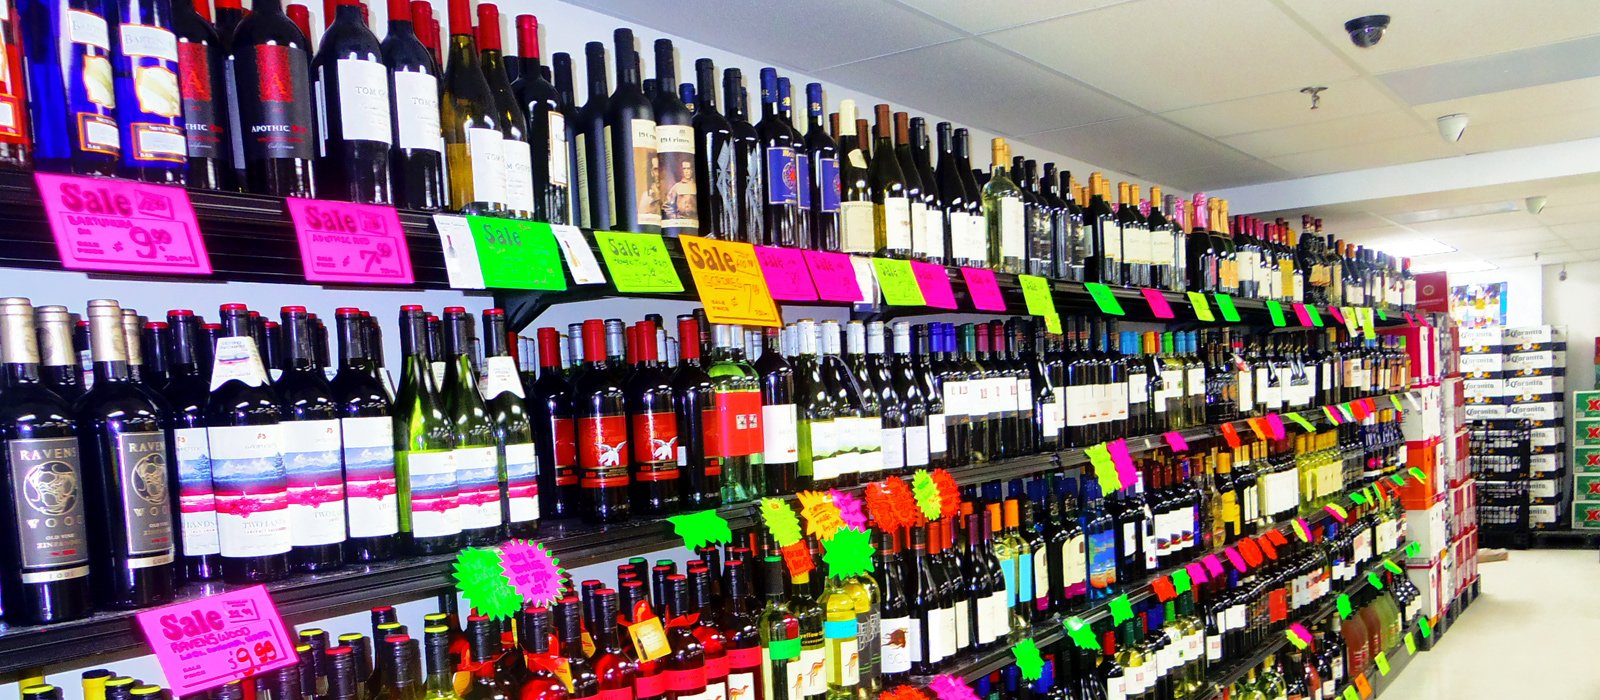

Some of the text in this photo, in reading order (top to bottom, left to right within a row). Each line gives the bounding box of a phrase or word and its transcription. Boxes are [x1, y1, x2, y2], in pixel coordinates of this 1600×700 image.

[356, 86, 376, 95] TOM
[185, 123, 208, 131] THIC
[251, 125, 291, 133] APOTHIC
[60, 182, 133, 217] Sale
[304, 205, 357, 233] Sale
[483, 223, 522, 247] Sale
[608, 238, 641, 257] Sale
[688, 241, 737, 273] Sale
[1512, 405, 1545, 414] Coronita
[133, 505, 169, 517] WOO
[160, 609, 224, 640] Sale
[800, 631, 819, 640] yellow
